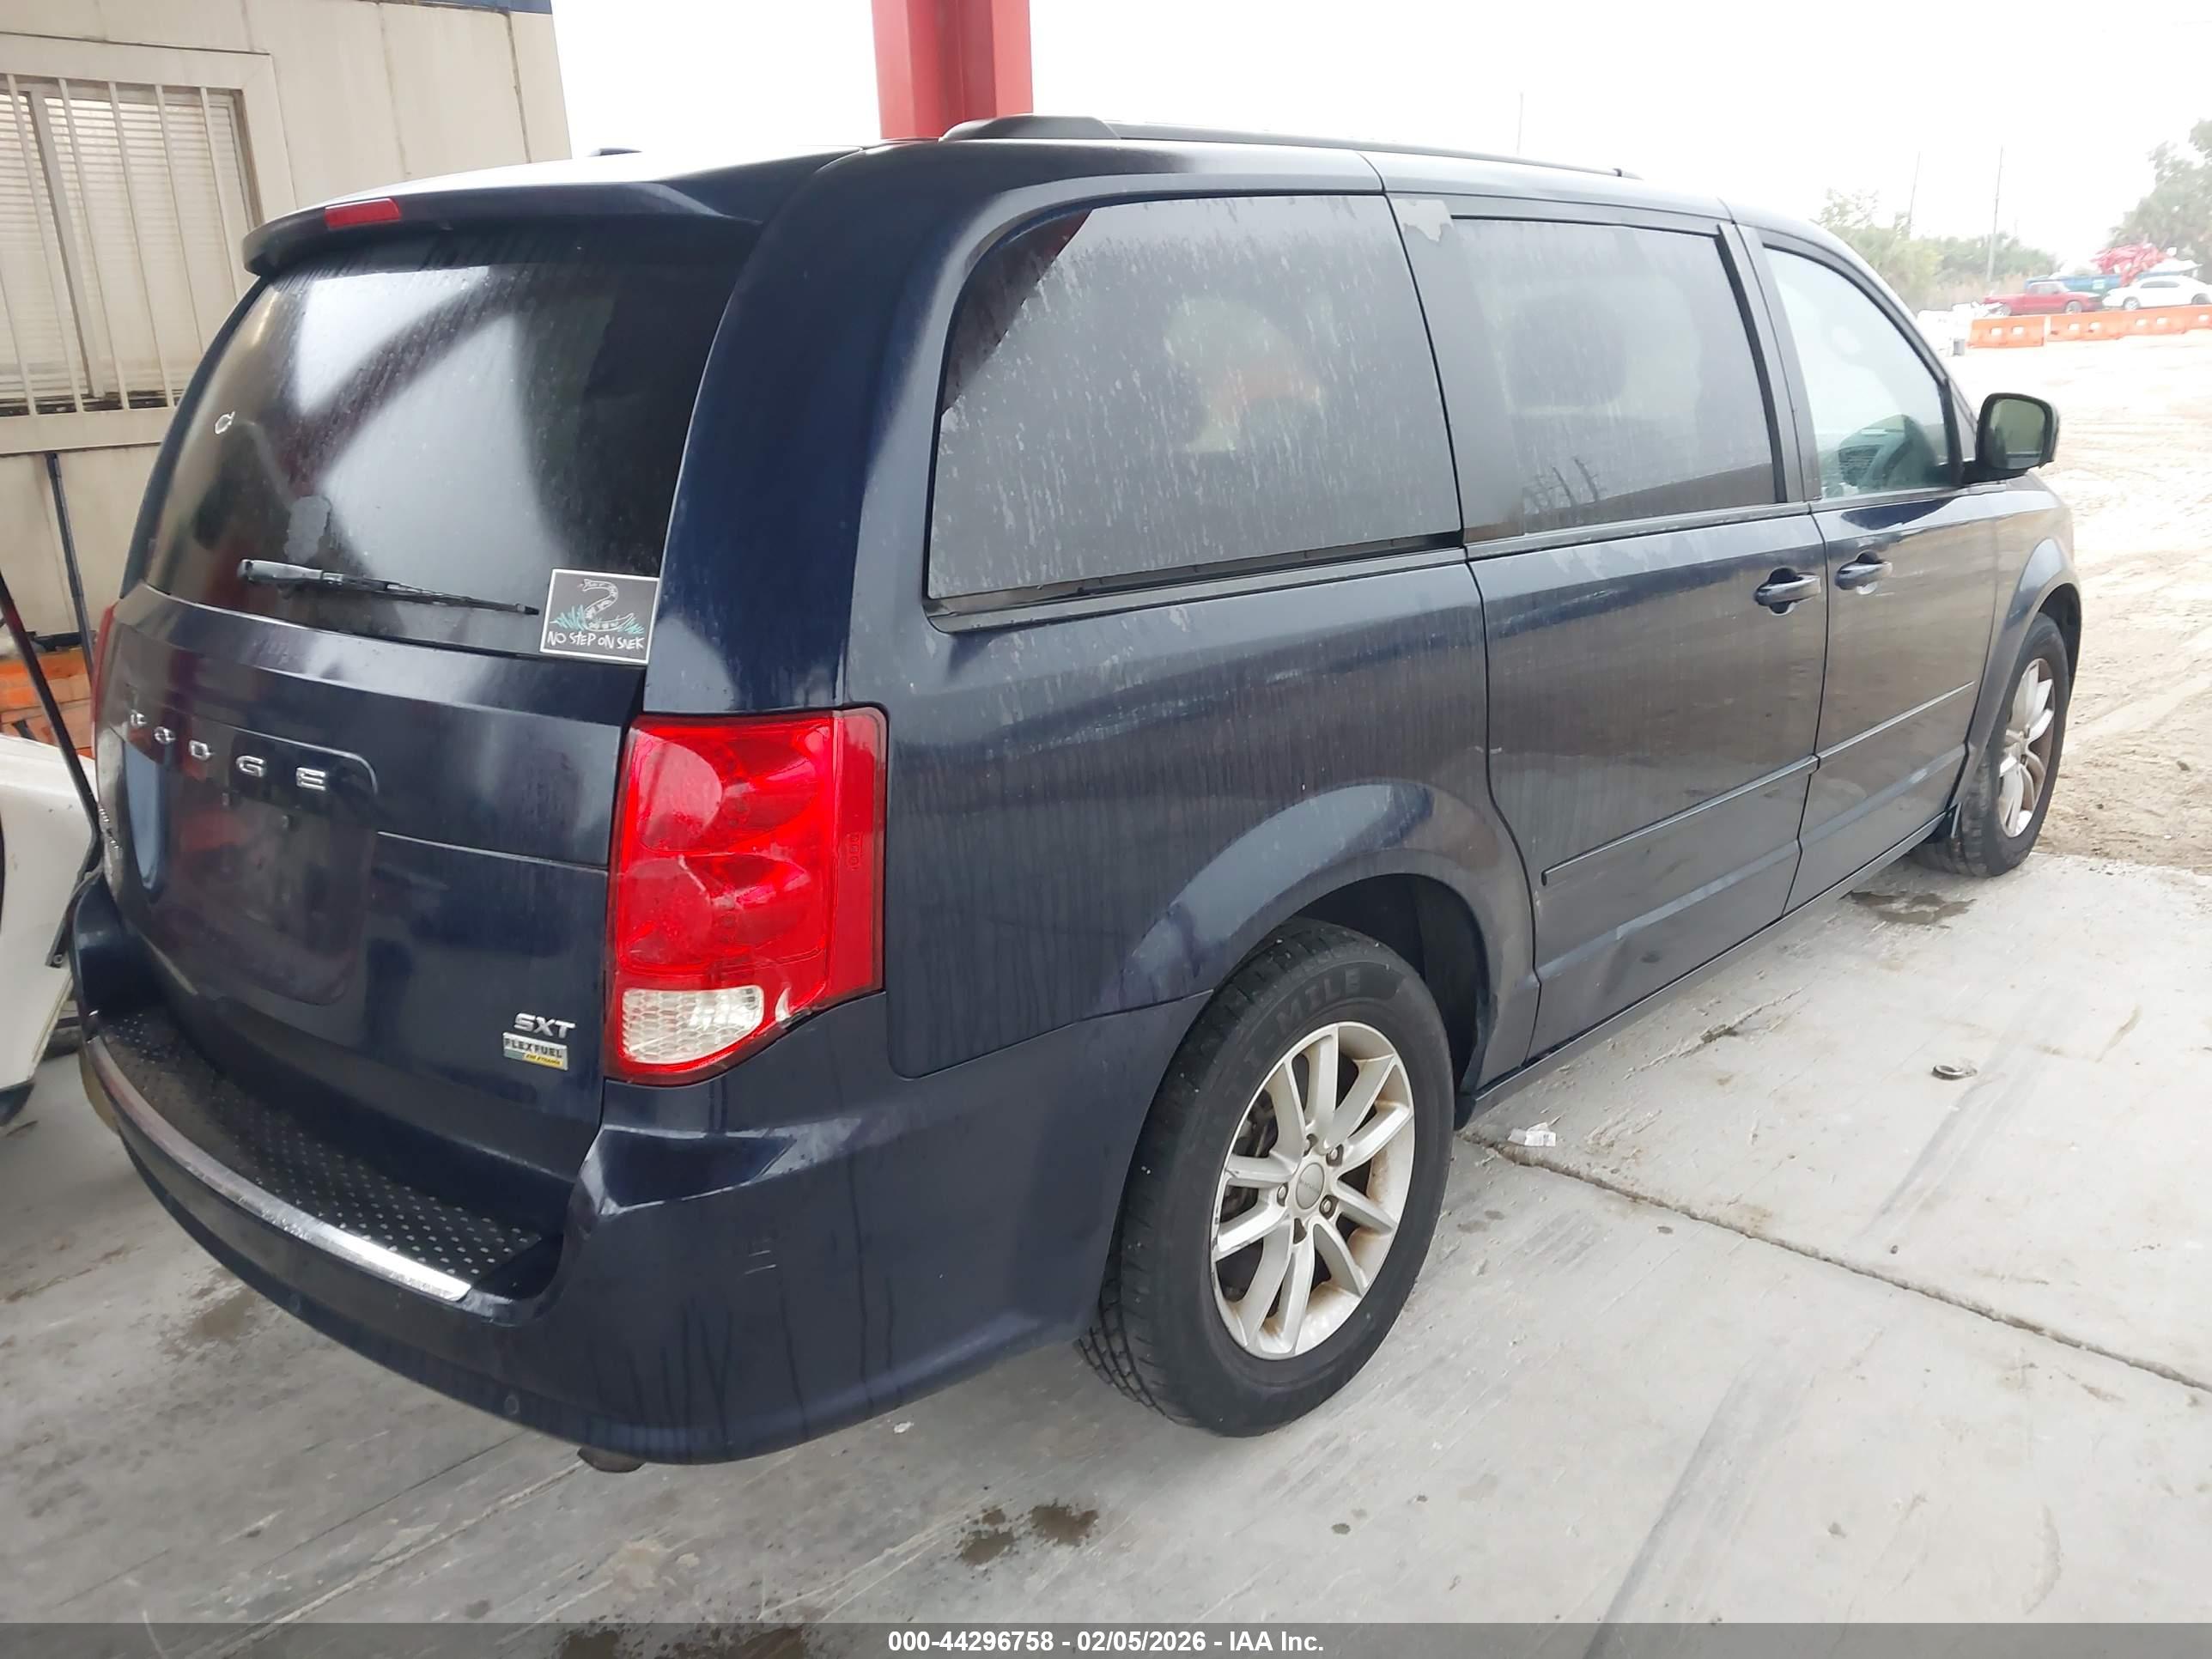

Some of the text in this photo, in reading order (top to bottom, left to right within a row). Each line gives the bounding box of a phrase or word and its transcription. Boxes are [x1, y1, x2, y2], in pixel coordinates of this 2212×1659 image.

[547, 631, 567, 646] NO
[568, 630, 597, 647] STEP
[598, 635, 615, 649] ON
[514, 1012, 576, 1039] SXT
